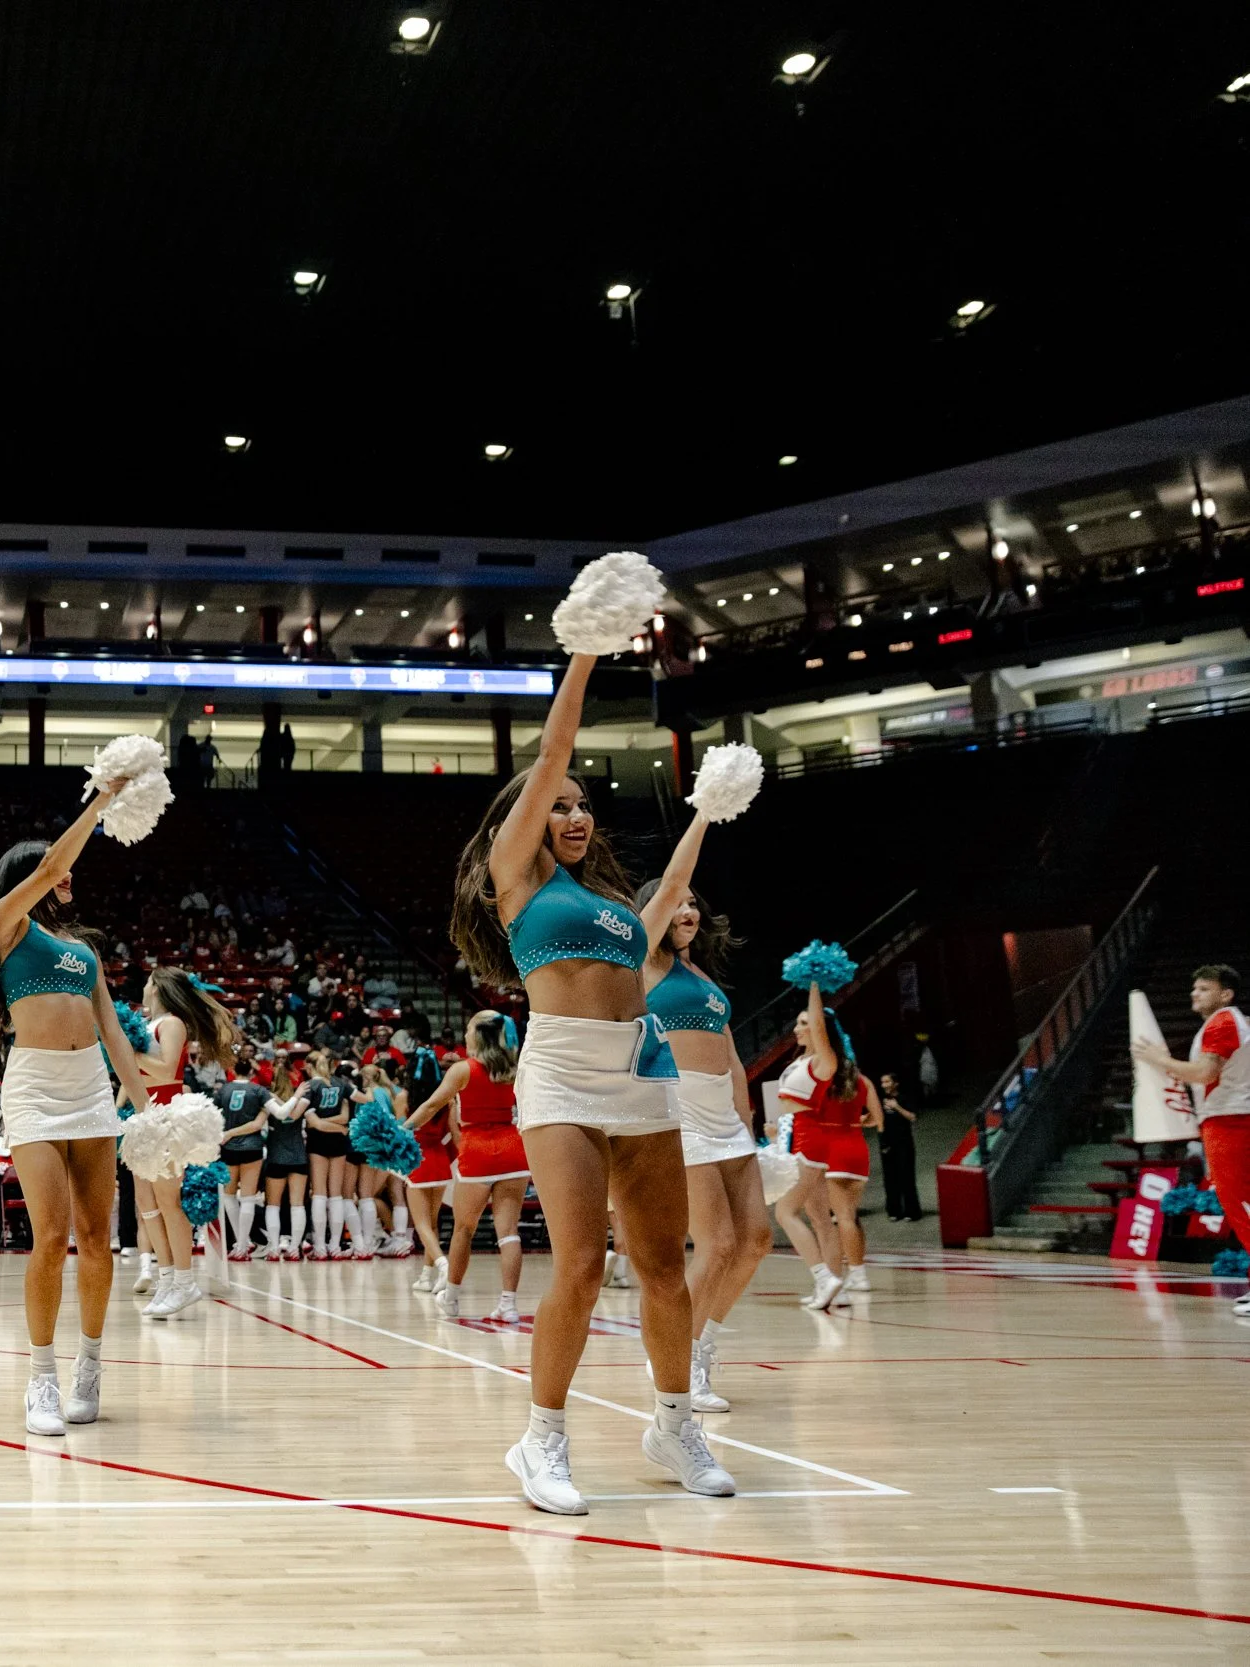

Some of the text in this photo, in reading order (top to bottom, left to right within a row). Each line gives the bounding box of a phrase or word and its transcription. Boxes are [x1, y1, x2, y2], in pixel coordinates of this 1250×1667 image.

[593, 909, 633, 940] Lobos
[54, 951, 87, 975] Lobos
[705, 992, 726, 1015] Lobos
[230, 1089, 247, 1111] 5
[319, 1086, 340, 1108] 13
[1127, 1203, 1156, 1257] HEY
